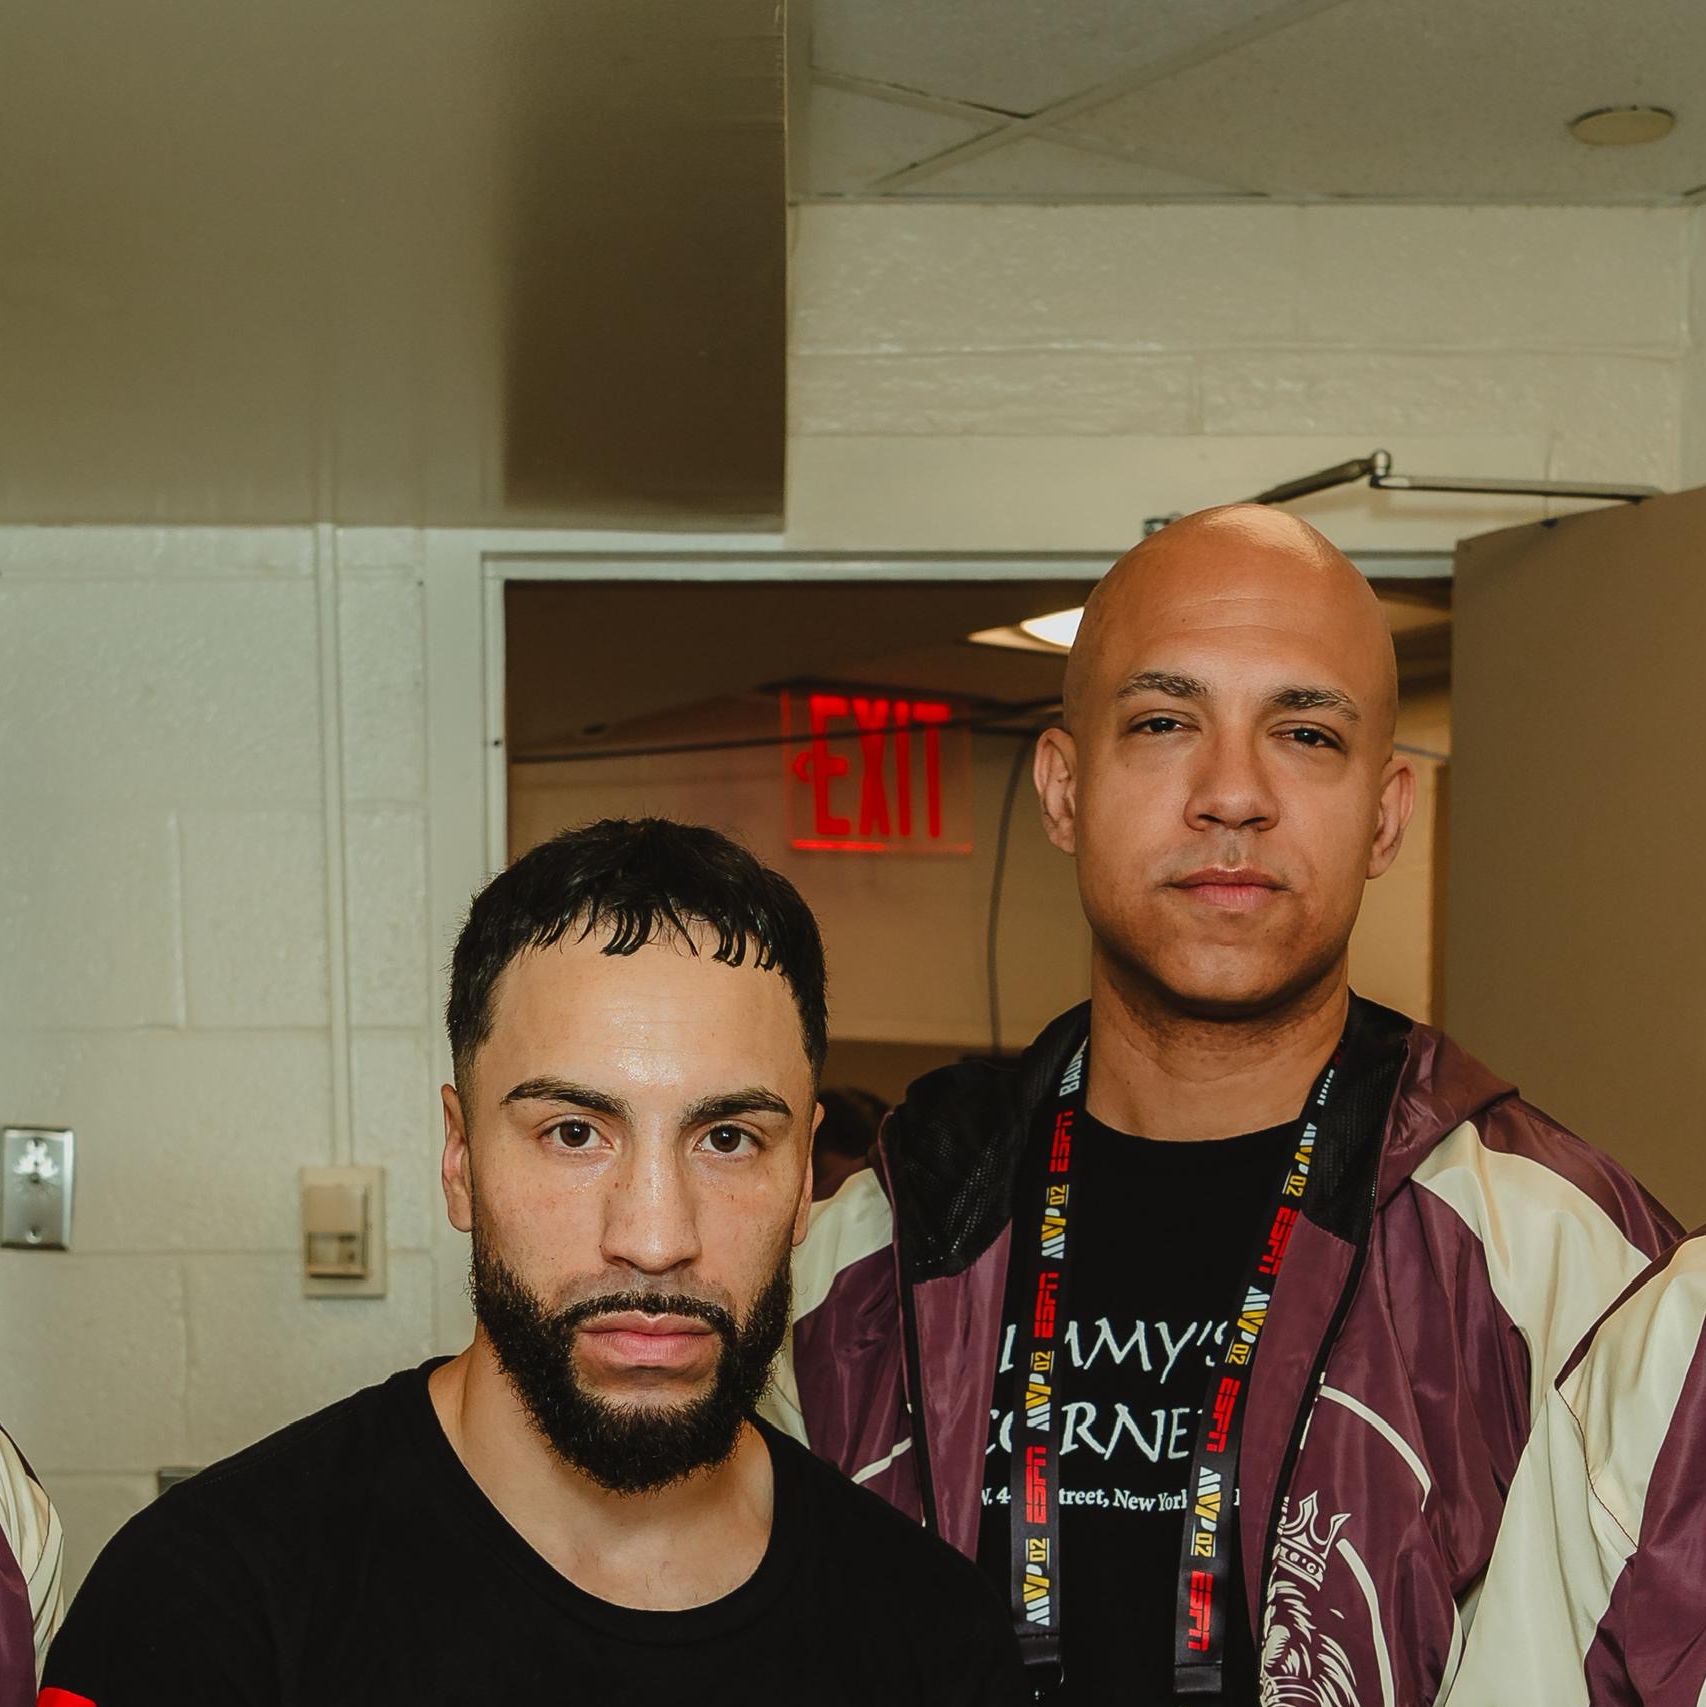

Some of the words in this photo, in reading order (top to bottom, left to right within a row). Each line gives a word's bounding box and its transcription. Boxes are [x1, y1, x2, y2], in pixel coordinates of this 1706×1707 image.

[810, 695, 951, 838] EXIT
[1049, 1110, 1074, 1172] ESPN
[1049, 1184, 1066, 1207] 02
[1286, 1175, 1307, 1197] 02
[1041, 1207, 1067, 1260] MVP
[1258, 1205, 1299, 1276] ESPN
[1034, 1272, 1059, 1338] ESPN
[1237, 1285, 1270, 1344] MVP
[1032, 1351, 1051, 1372] 02
[1228, 1342, 1250, 1366] 02
[1025, 1373, 1052, 1431] MVP
[1206, 1376, 1241, 1453] ESPN
[1025, 1446, 1047, 1523] ESPN
[1059, 1488, 1110, 1507] treet,
[1113, 1489, 1156, 1511] New
[1194, 1465, 1221, 1532] MVP
[1029, 1538, 1046, 1561] 02
[1194, 1532, 1213, 1557] 02
[1023, 1564, 1050, 1626] MVP
[1188, 1570, 1213, 1652] ESPN
